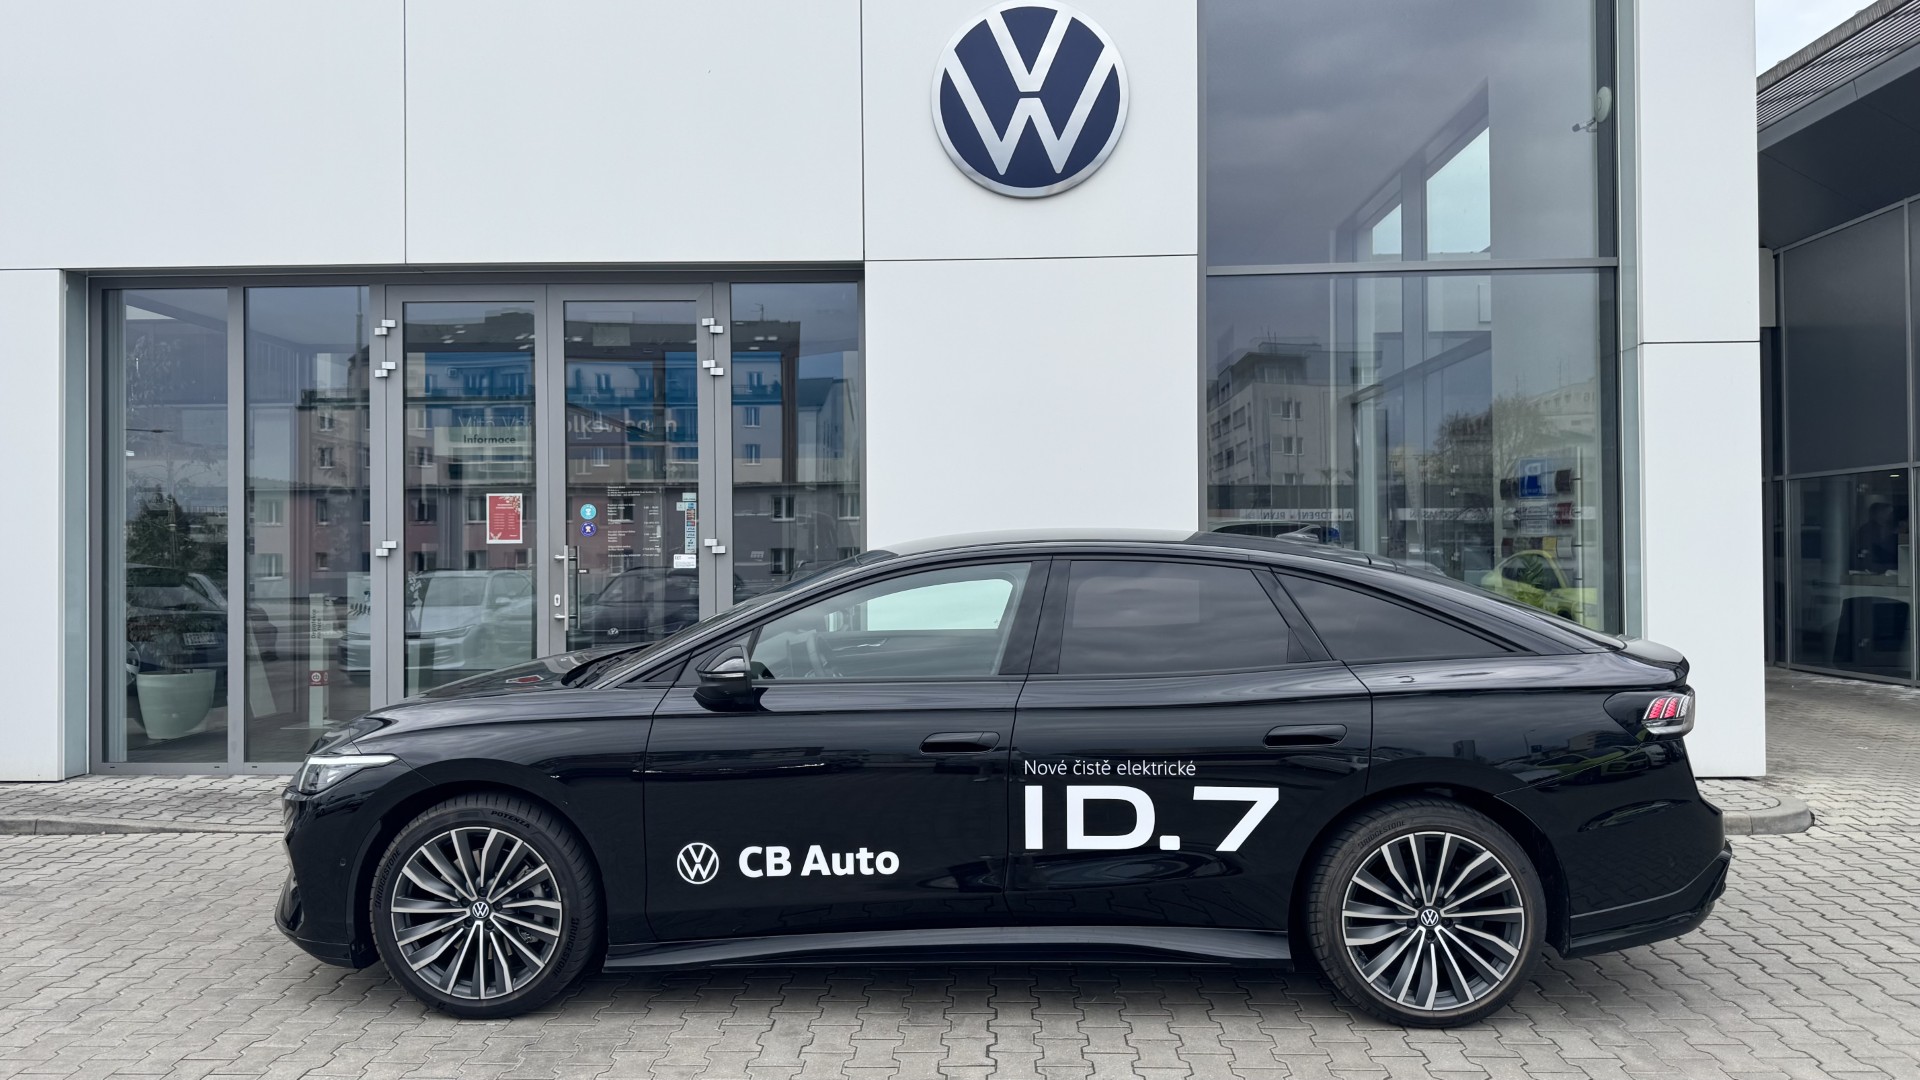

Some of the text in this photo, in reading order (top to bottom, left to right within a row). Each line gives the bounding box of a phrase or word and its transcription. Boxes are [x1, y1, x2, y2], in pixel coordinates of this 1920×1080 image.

[463, 434, 516, 444] Informace
[1024, 759, 1196, 776] Nové čistě elektrické
[490, 810, 530, 829] POTENZA
[1024, 785, 1280, 852] ID.7
[1357, 819, 1407, 849] BRIDGESTONE
[738, 843, 900, 878] CB Auto
[375, 849, 402, 910] BRIDGESTONE
